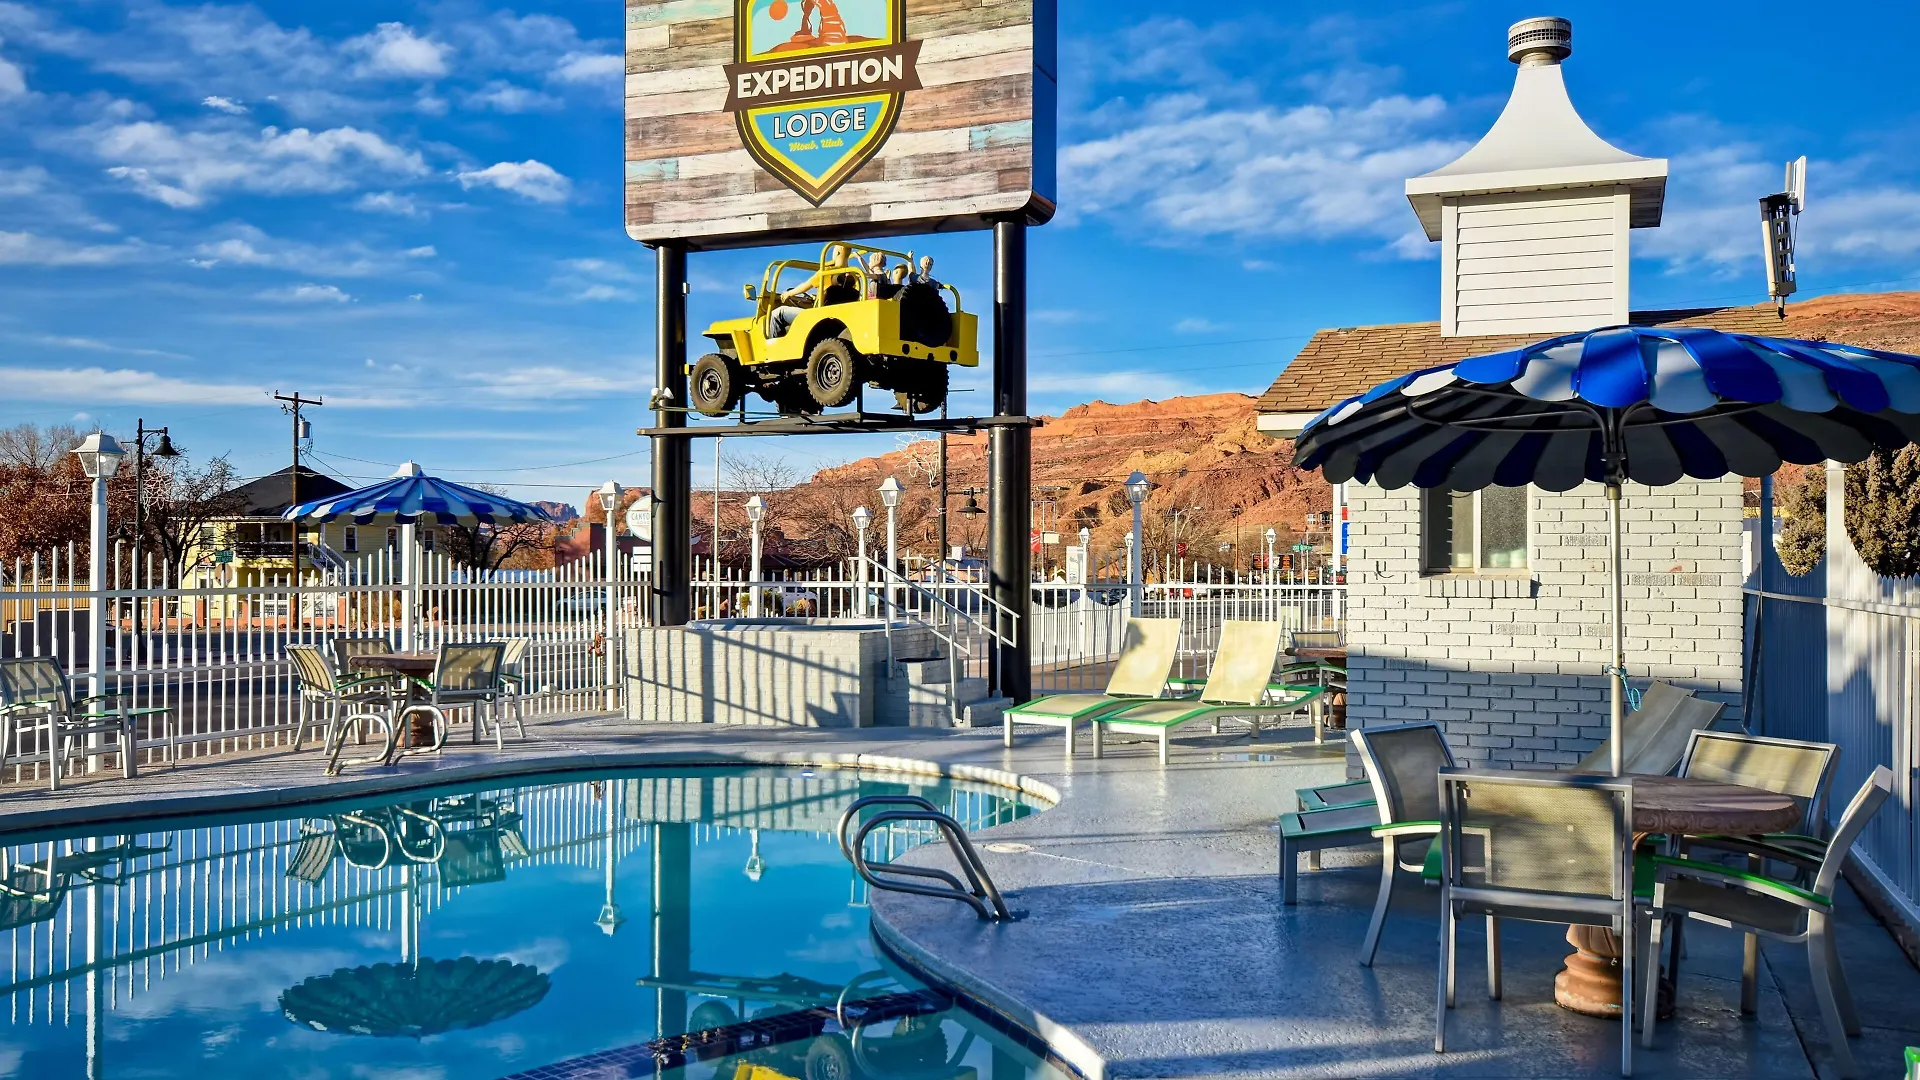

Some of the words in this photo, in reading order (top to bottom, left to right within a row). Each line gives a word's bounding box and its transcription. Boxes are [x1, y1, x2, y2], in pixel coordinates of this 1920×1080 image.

[737, 54, 903, 99] EXPEDITION
[773, 107, 867, 139] LODGE
[789, 141, 818, 152] Moab,
[821, 137, 844, 149] Utah
[631, 512, 650, 520] CANYO
